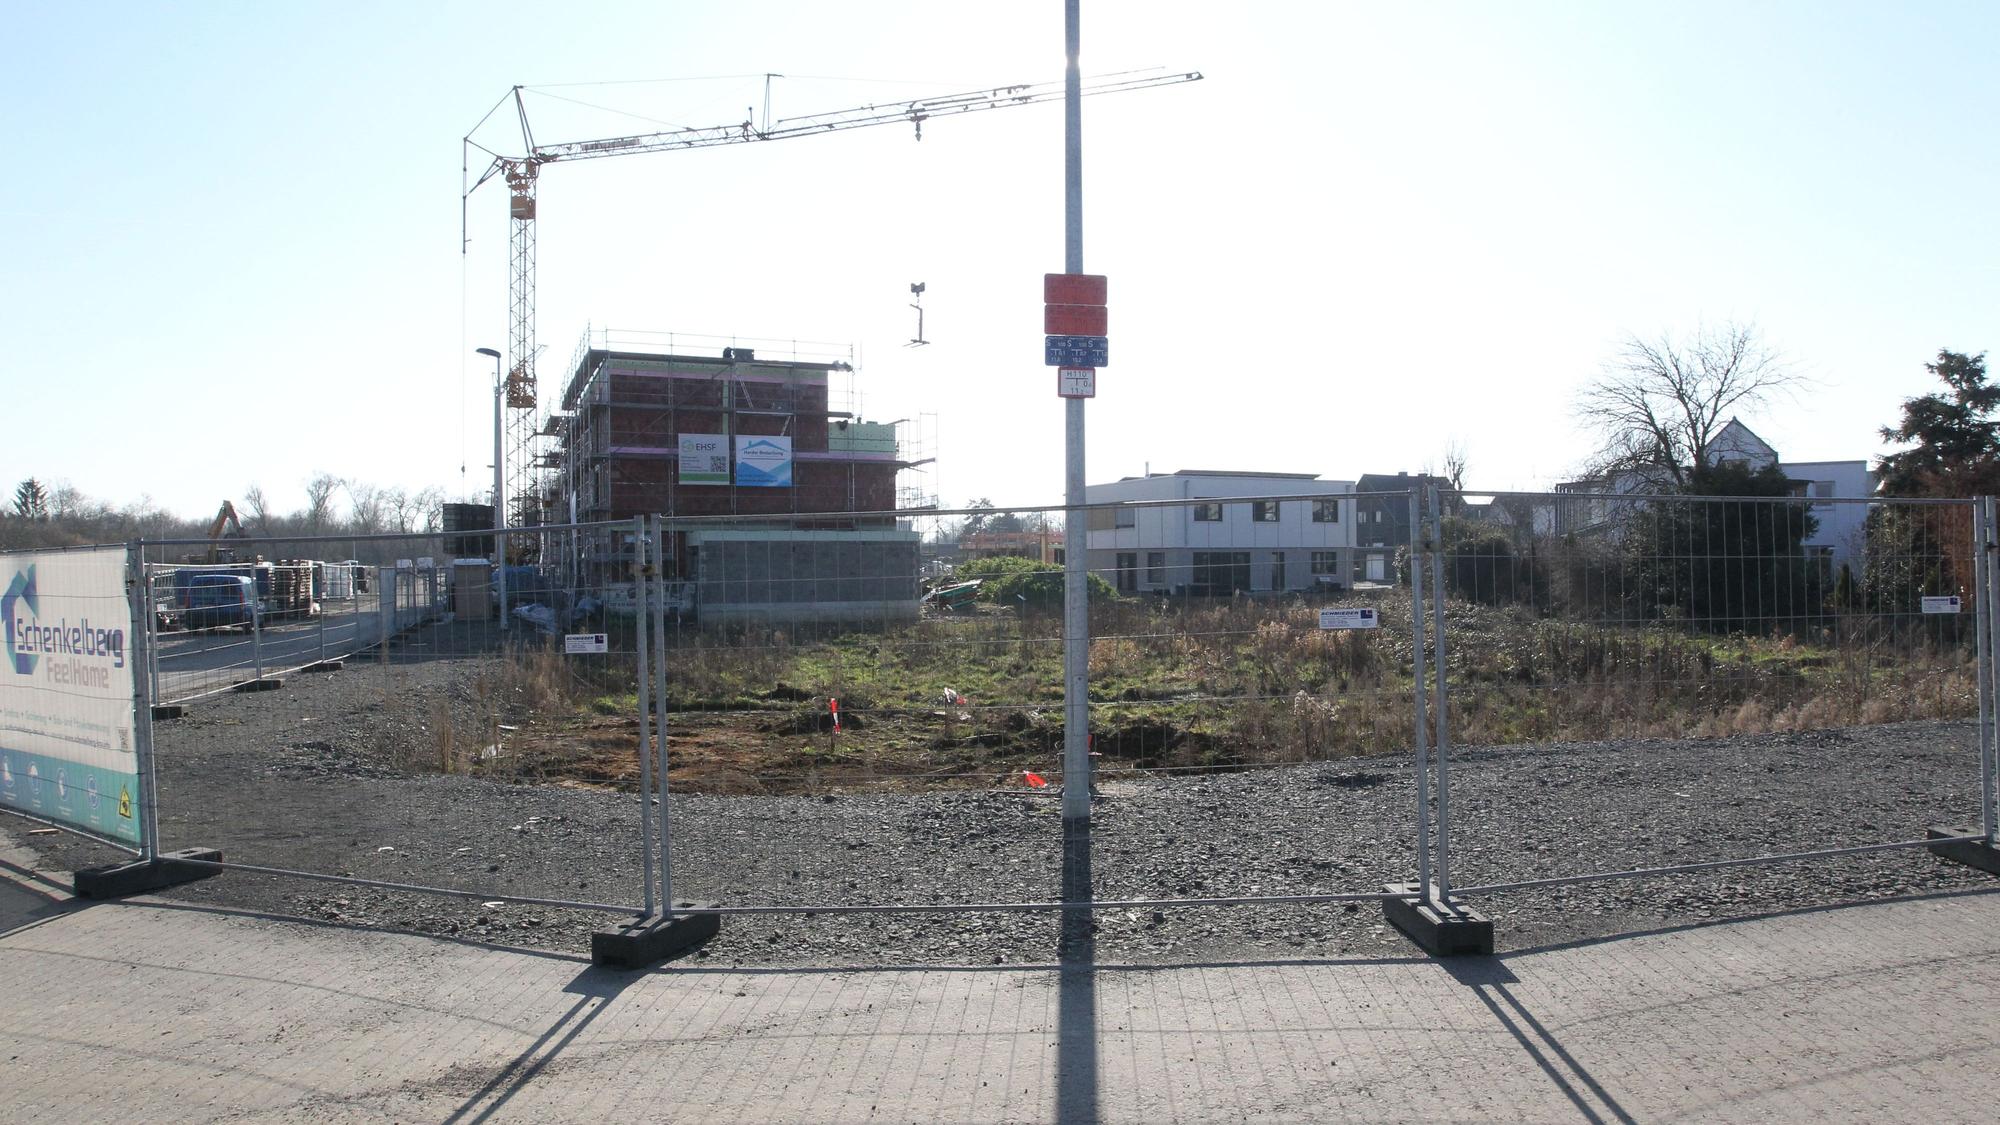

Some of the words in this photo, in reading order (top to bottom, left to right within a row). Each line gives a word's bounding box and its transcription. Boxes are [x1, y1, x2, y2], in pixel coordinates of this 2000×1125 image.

[1066, 370, 1087, 378] H110
[695, 443, 716, 451] EHSF
[16, 617, 124, 668] Schenkelberg
[46, 657, 110, 688] FeelHome
